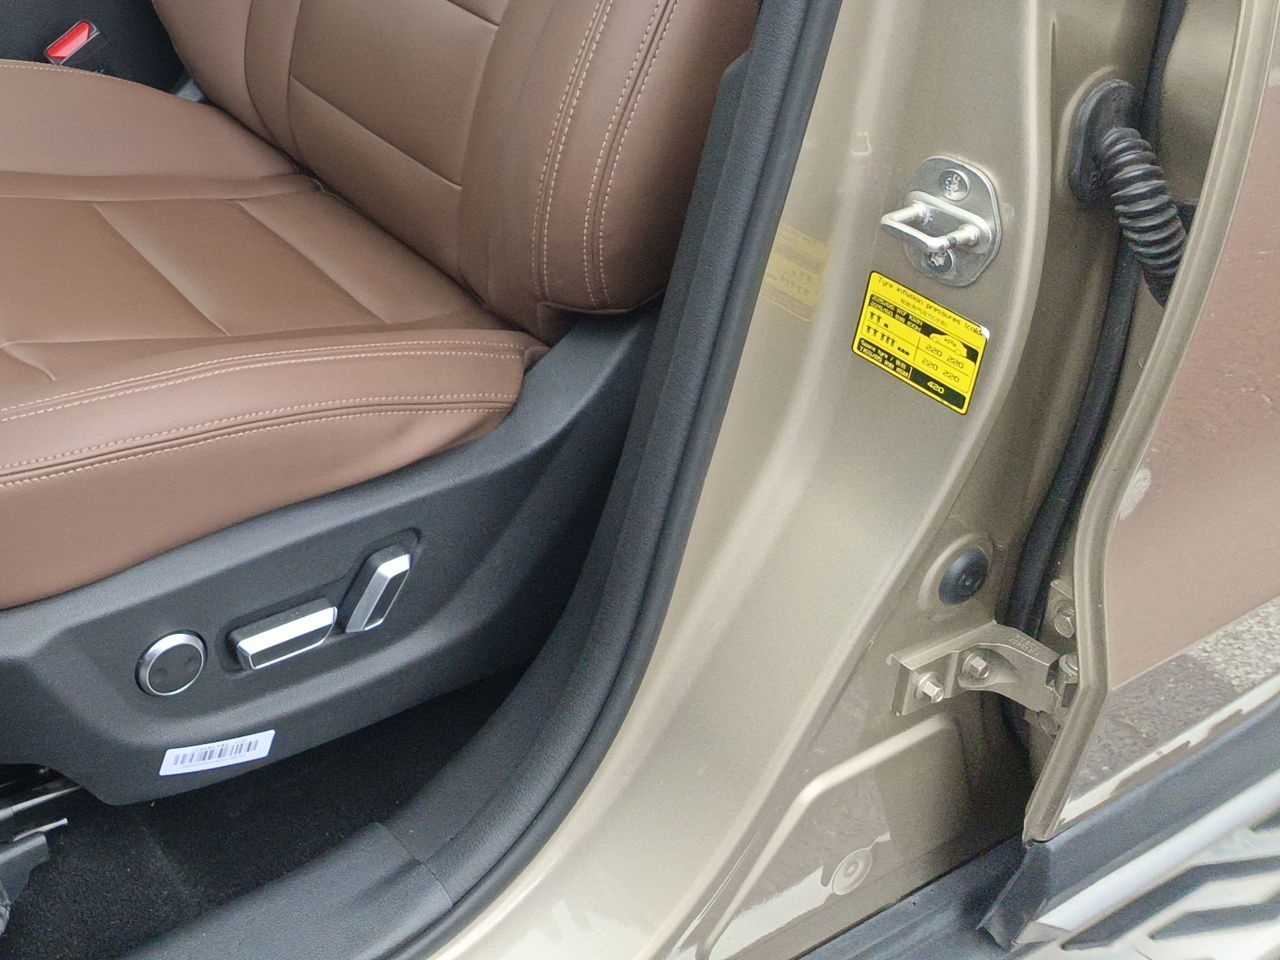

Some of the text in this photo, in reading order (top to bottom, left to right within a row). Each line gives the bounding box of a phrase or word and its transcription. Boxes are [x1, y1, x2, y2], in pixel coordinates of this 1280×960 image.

[878, 276, 894, 289] Tyre
[925, 303, 960, 326] pressures
[925, 343, 965, 370] 220 220
[921, 357, 960, 383] 220 220
[926, 380, 945, 395] 420
